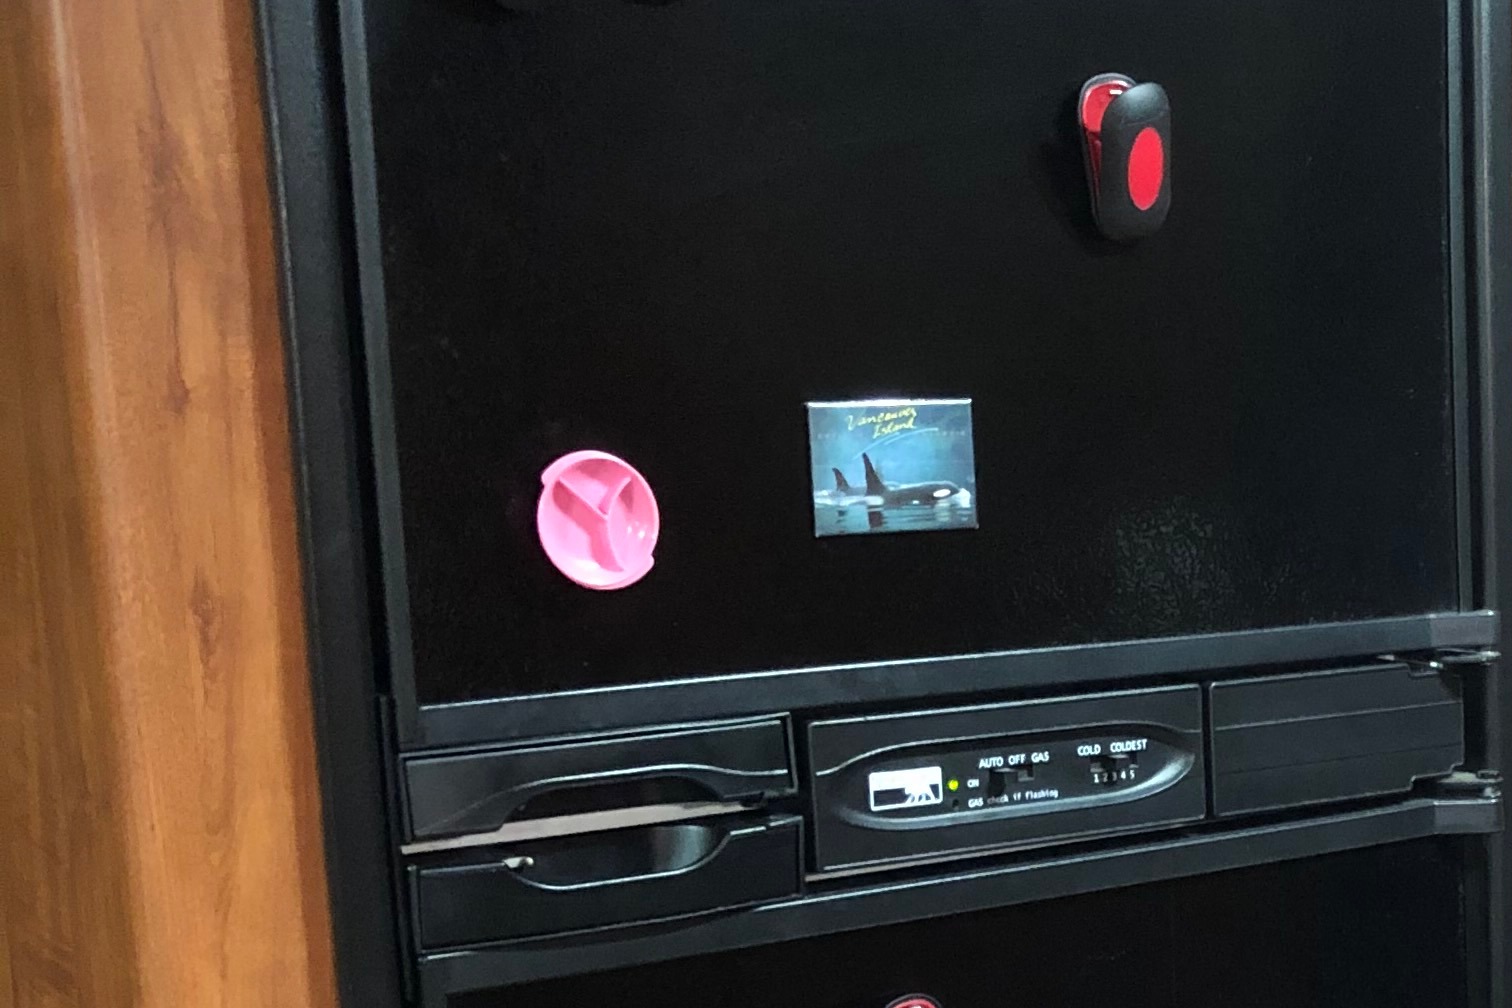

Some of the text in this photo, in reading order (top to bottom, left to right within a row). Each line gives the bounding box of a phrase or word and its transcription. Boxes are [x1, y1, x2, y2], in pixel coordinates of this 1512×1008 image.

[1077, 738, 1147, 756] COLD COLDEST
[978, 751, 1050, 769] AUTO OFF GAS
[967, 779, 979, 788] ON
[1093, 773, 1099, 783] 1
[1120, 770, 1127, 780] 4
[1129, 769, 1135, 780] 5
[967, 797, 984, 808] GAS
[1025, 788, 1059, 800] flashing
